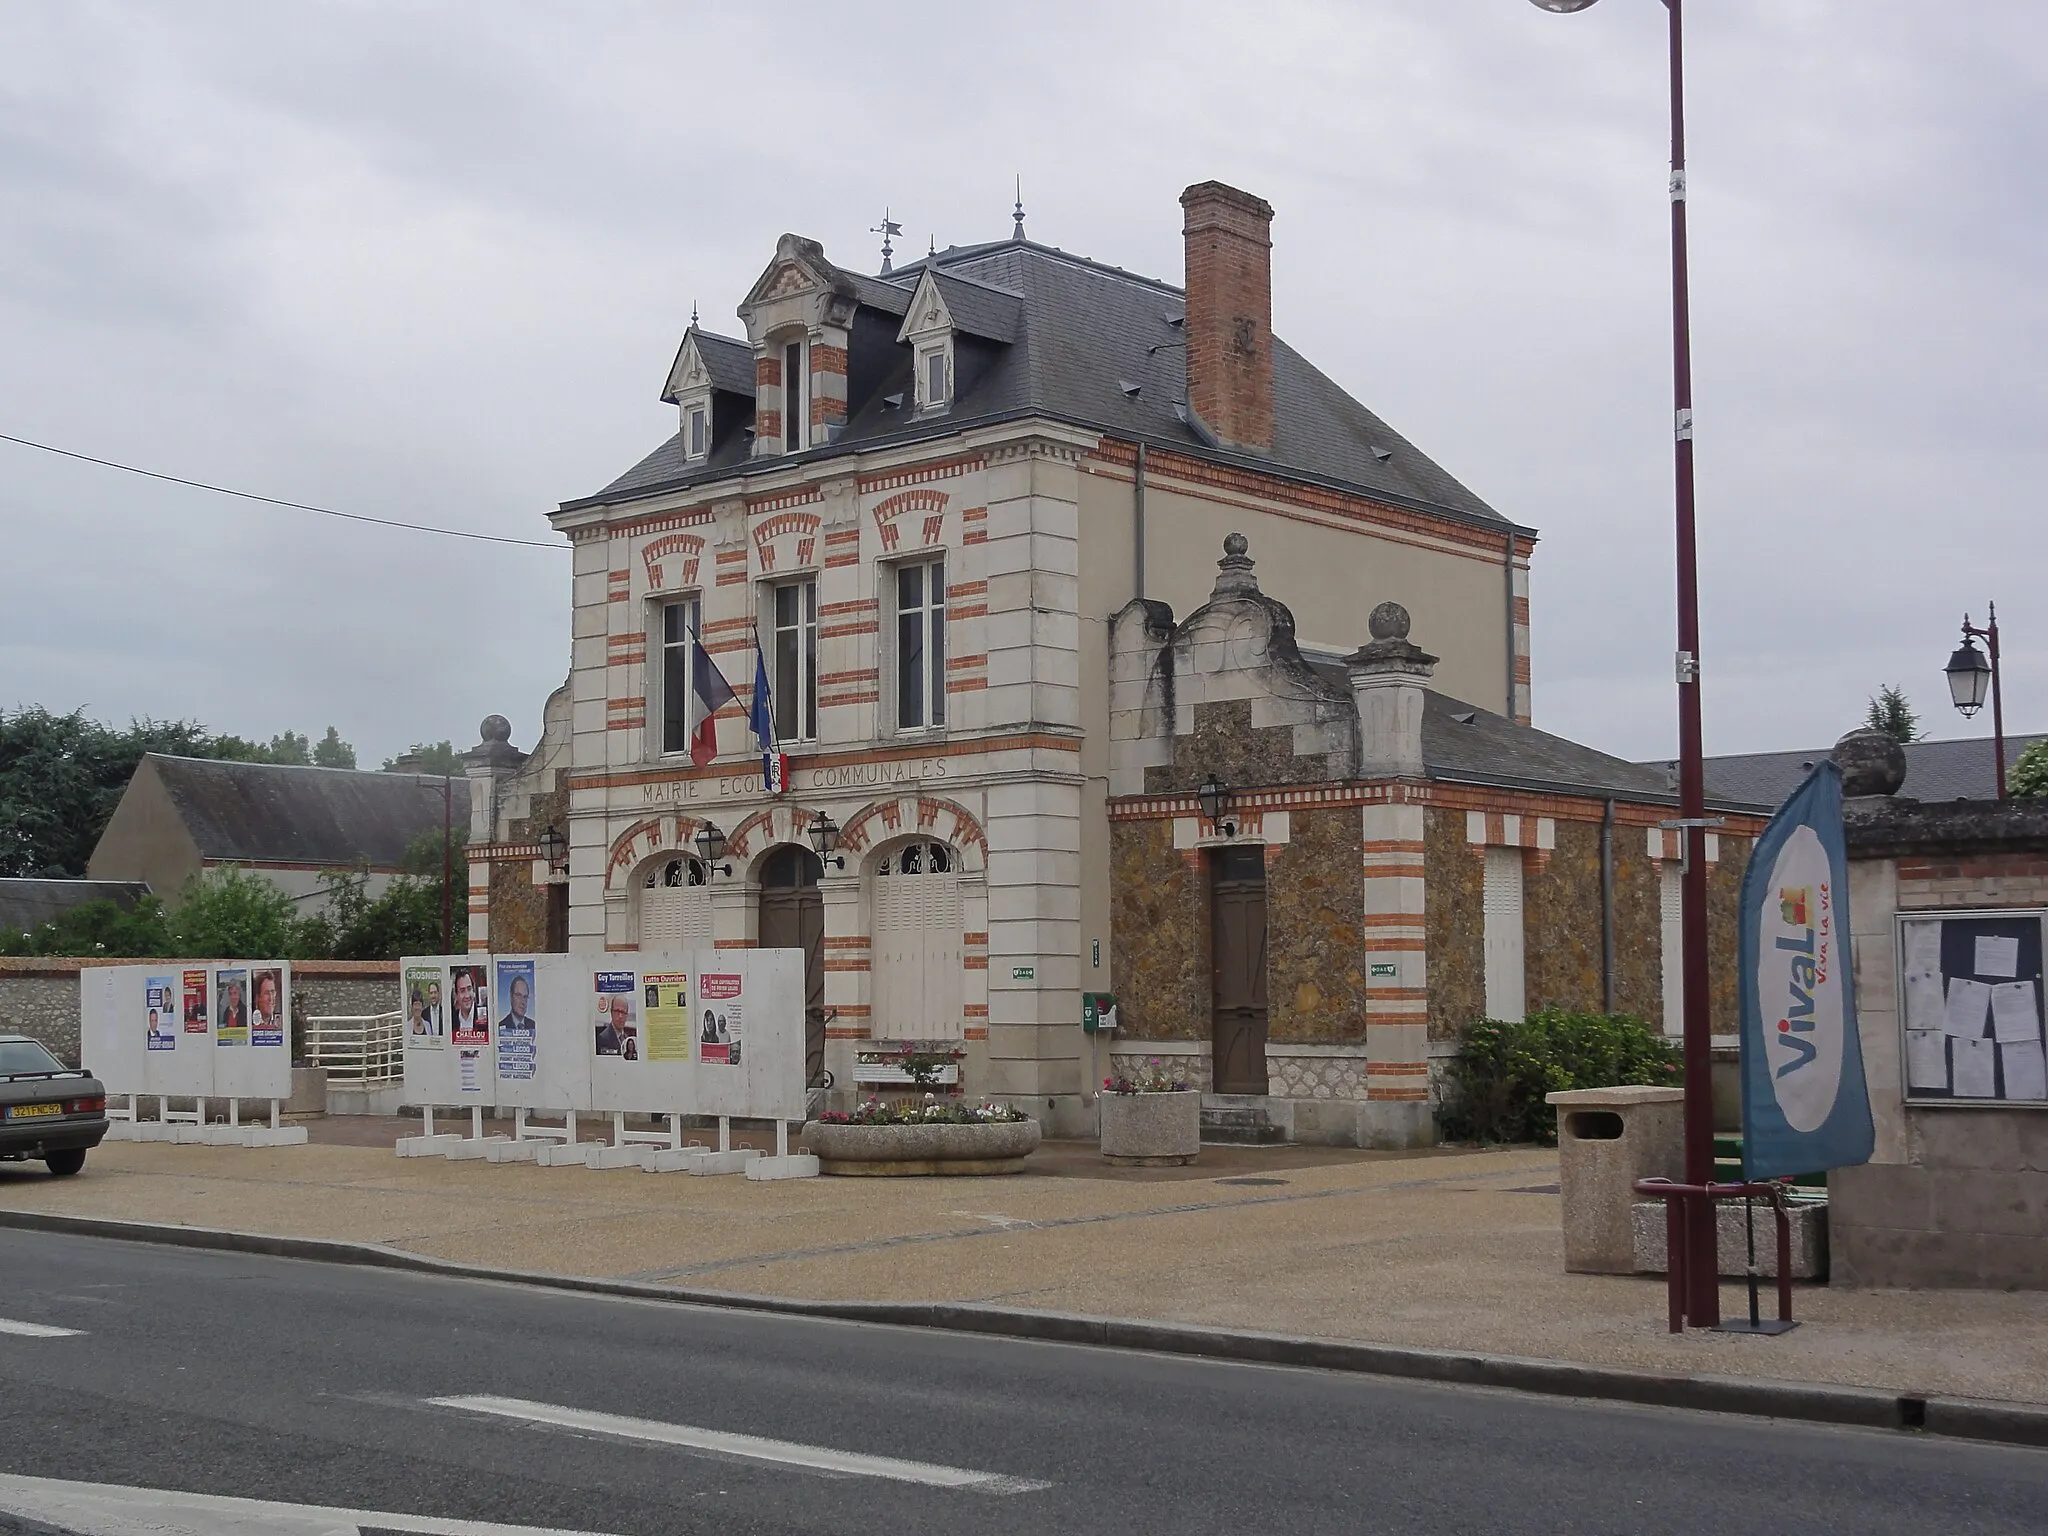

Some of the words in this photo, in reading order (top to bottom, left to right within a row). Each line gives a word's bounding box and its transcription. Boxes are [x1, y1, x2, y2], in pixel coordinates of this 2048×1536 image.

[643, 780, 699, 802] MAIRIE
[720, 776, 766, 796] ECOL
[813, 758, 947, 788] COMMUNALES
[1820, 883, 1829, 910] vie
[406, 971, 441, 980] CROSNIER
[1815, 941, 1829, 984] Viva
[597, 973, 608, 983] Guy
